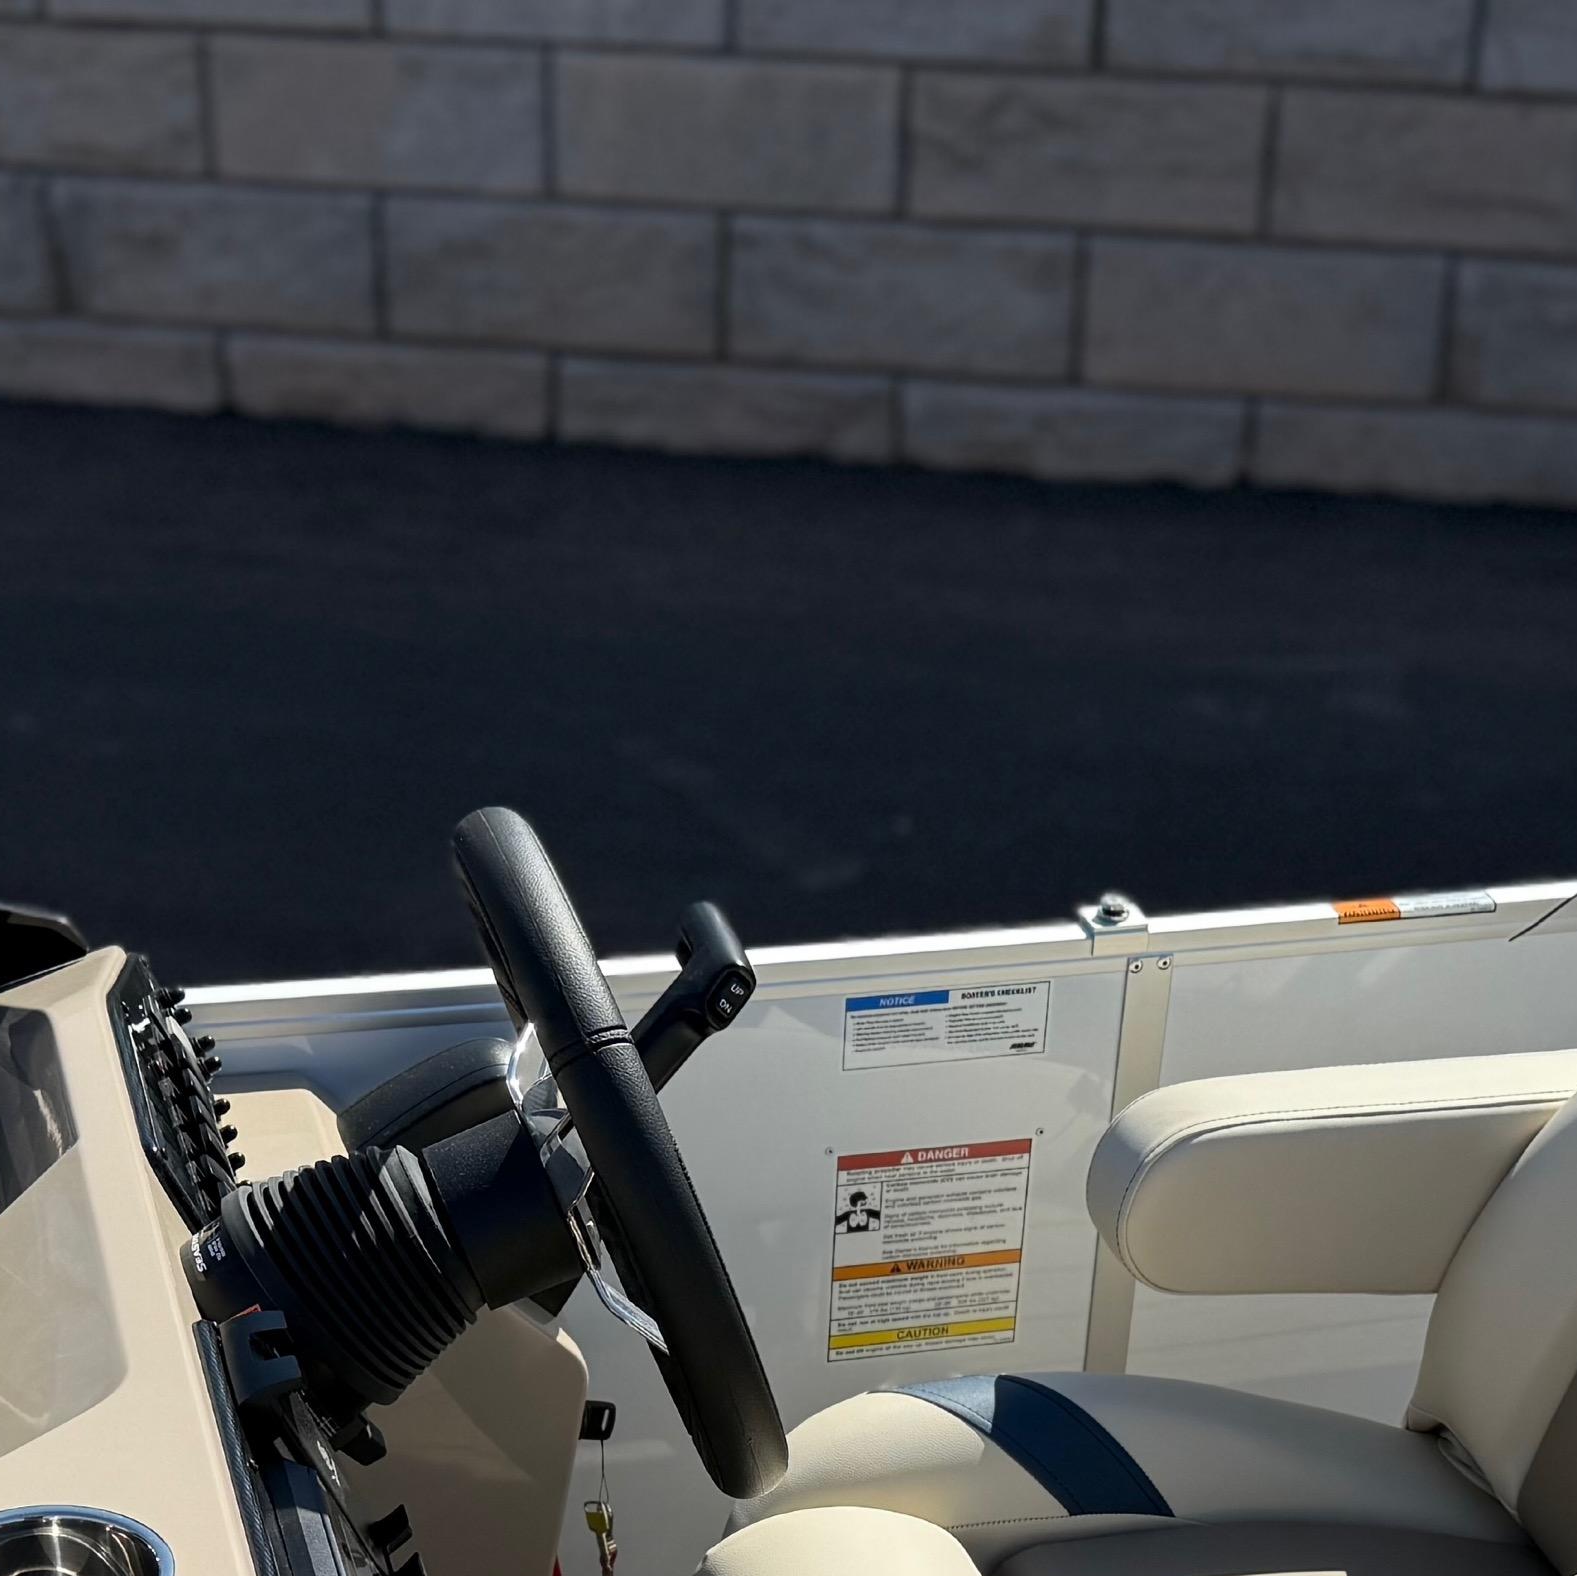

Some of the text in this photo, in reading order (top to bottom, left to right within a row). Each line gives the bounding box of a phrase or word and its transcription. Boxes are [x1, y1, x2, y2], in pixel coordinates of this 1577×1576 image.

[730, 983, 745, 996] UP
[879, 995, 916, 1007] NOTICE
[917, 1147, 969, 1162] DANGER
[906, 1256, 966, 1271] WARNING
[896, 1326, 949, 1340] CAUTION
